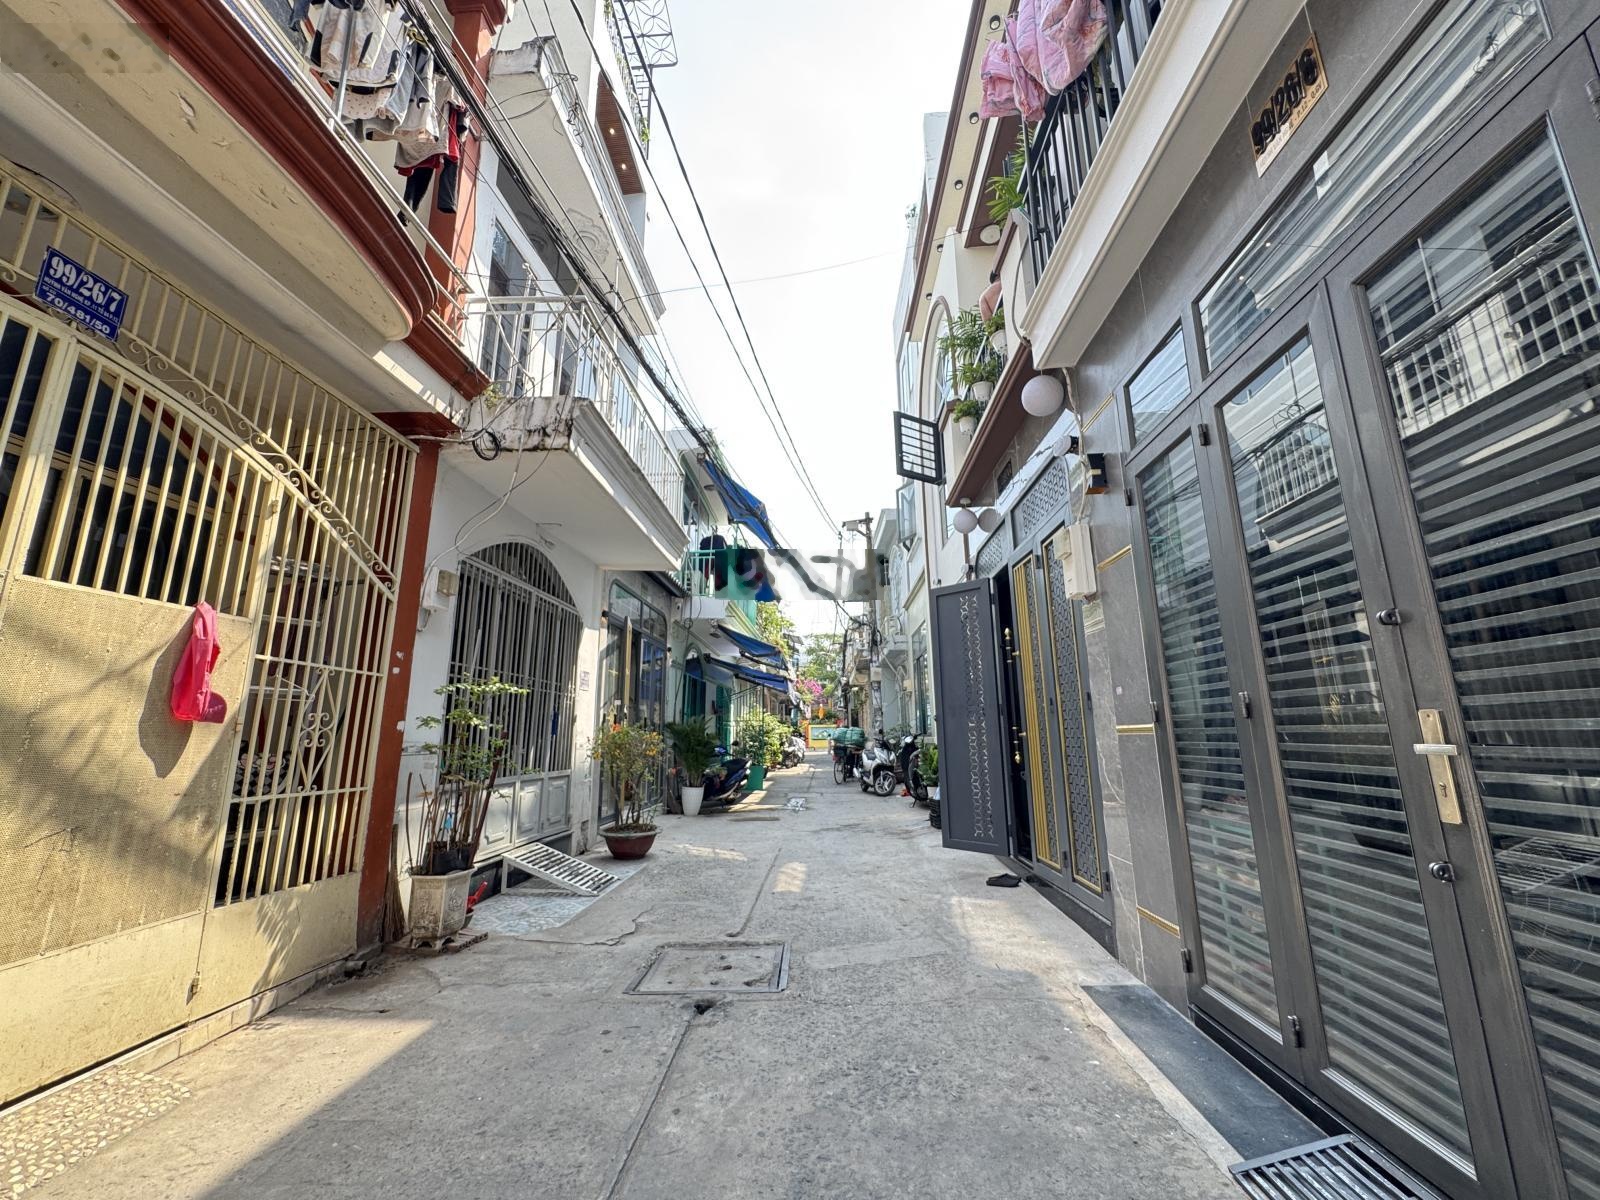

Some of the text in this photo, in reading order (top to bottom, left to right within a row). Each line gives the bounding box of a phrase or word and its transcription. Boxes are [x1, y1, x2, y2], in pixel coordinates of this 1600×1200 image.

[1252, 48, 1319, 155] 99/26/6
[46, 291, 110, 334] 70/481/50
[49, 256, 122, 313] 99/26/7
